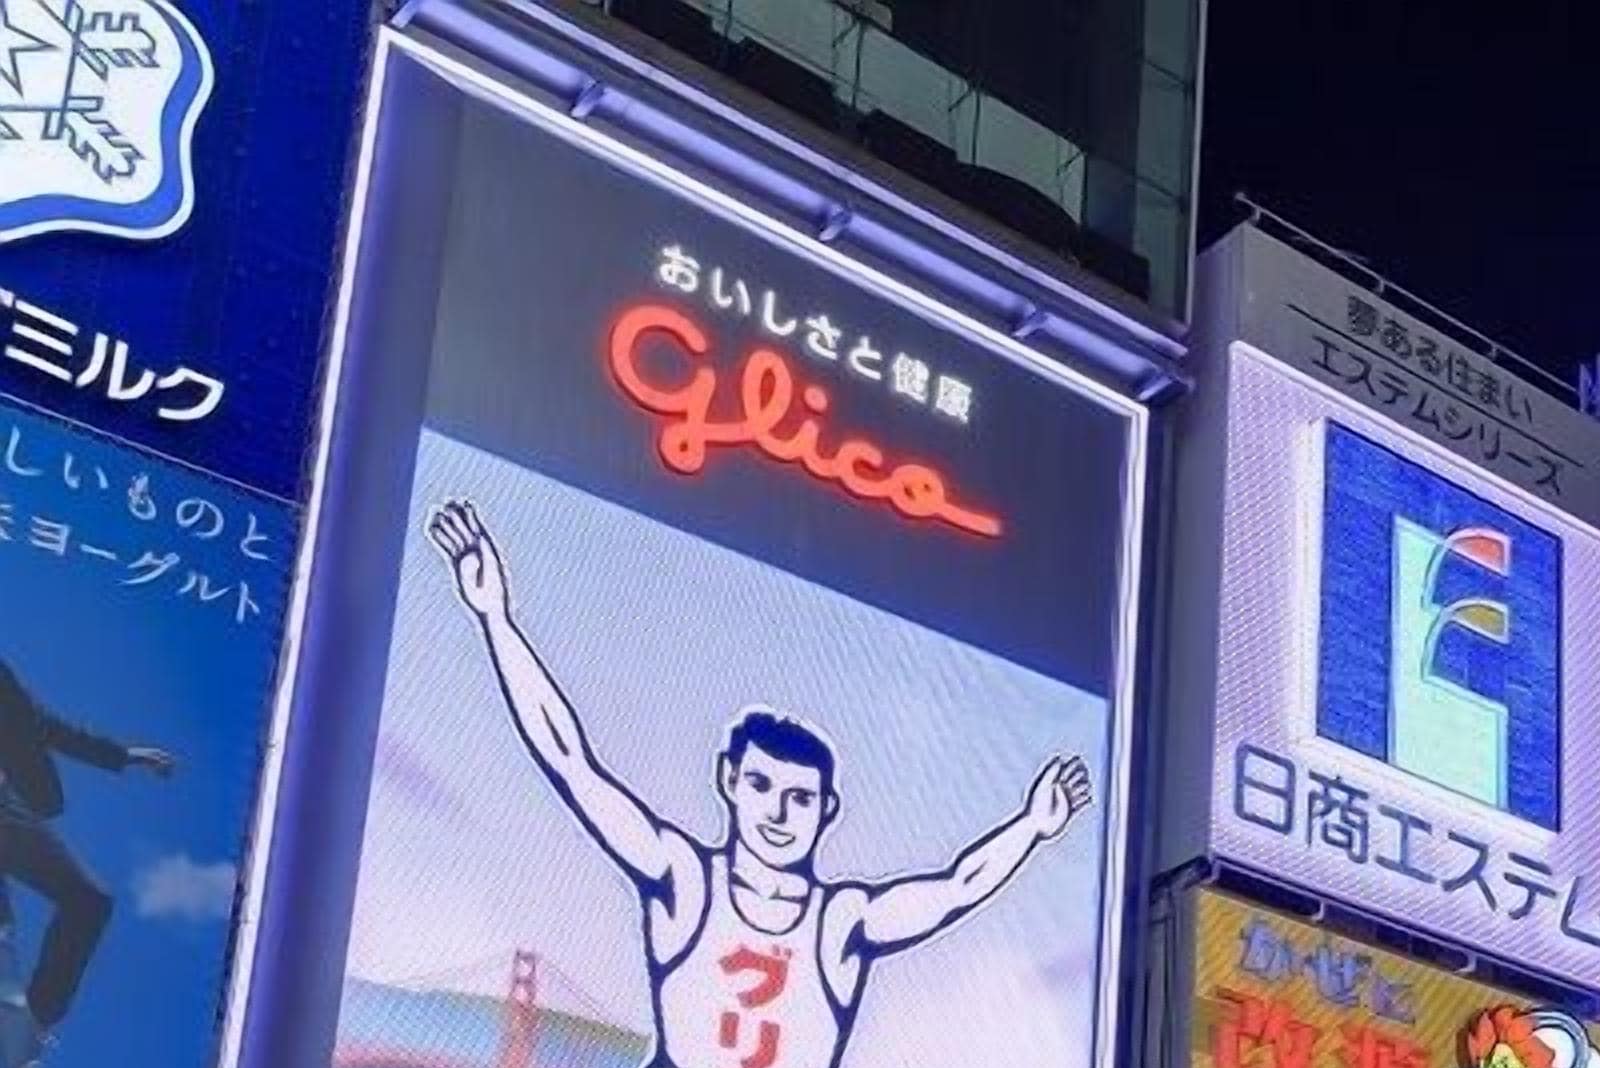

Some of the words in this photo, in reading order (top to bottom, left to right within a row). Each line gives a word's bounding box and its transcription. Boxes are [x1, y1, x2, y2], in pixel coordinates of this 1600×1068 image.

[0, 287, 225, 421] ミルク
[658, 244, 973, 423] おいしさと健康
[1310, 333, 1561, 497] エステムシリーズ
[609, 303, 1003, 538] Glico
